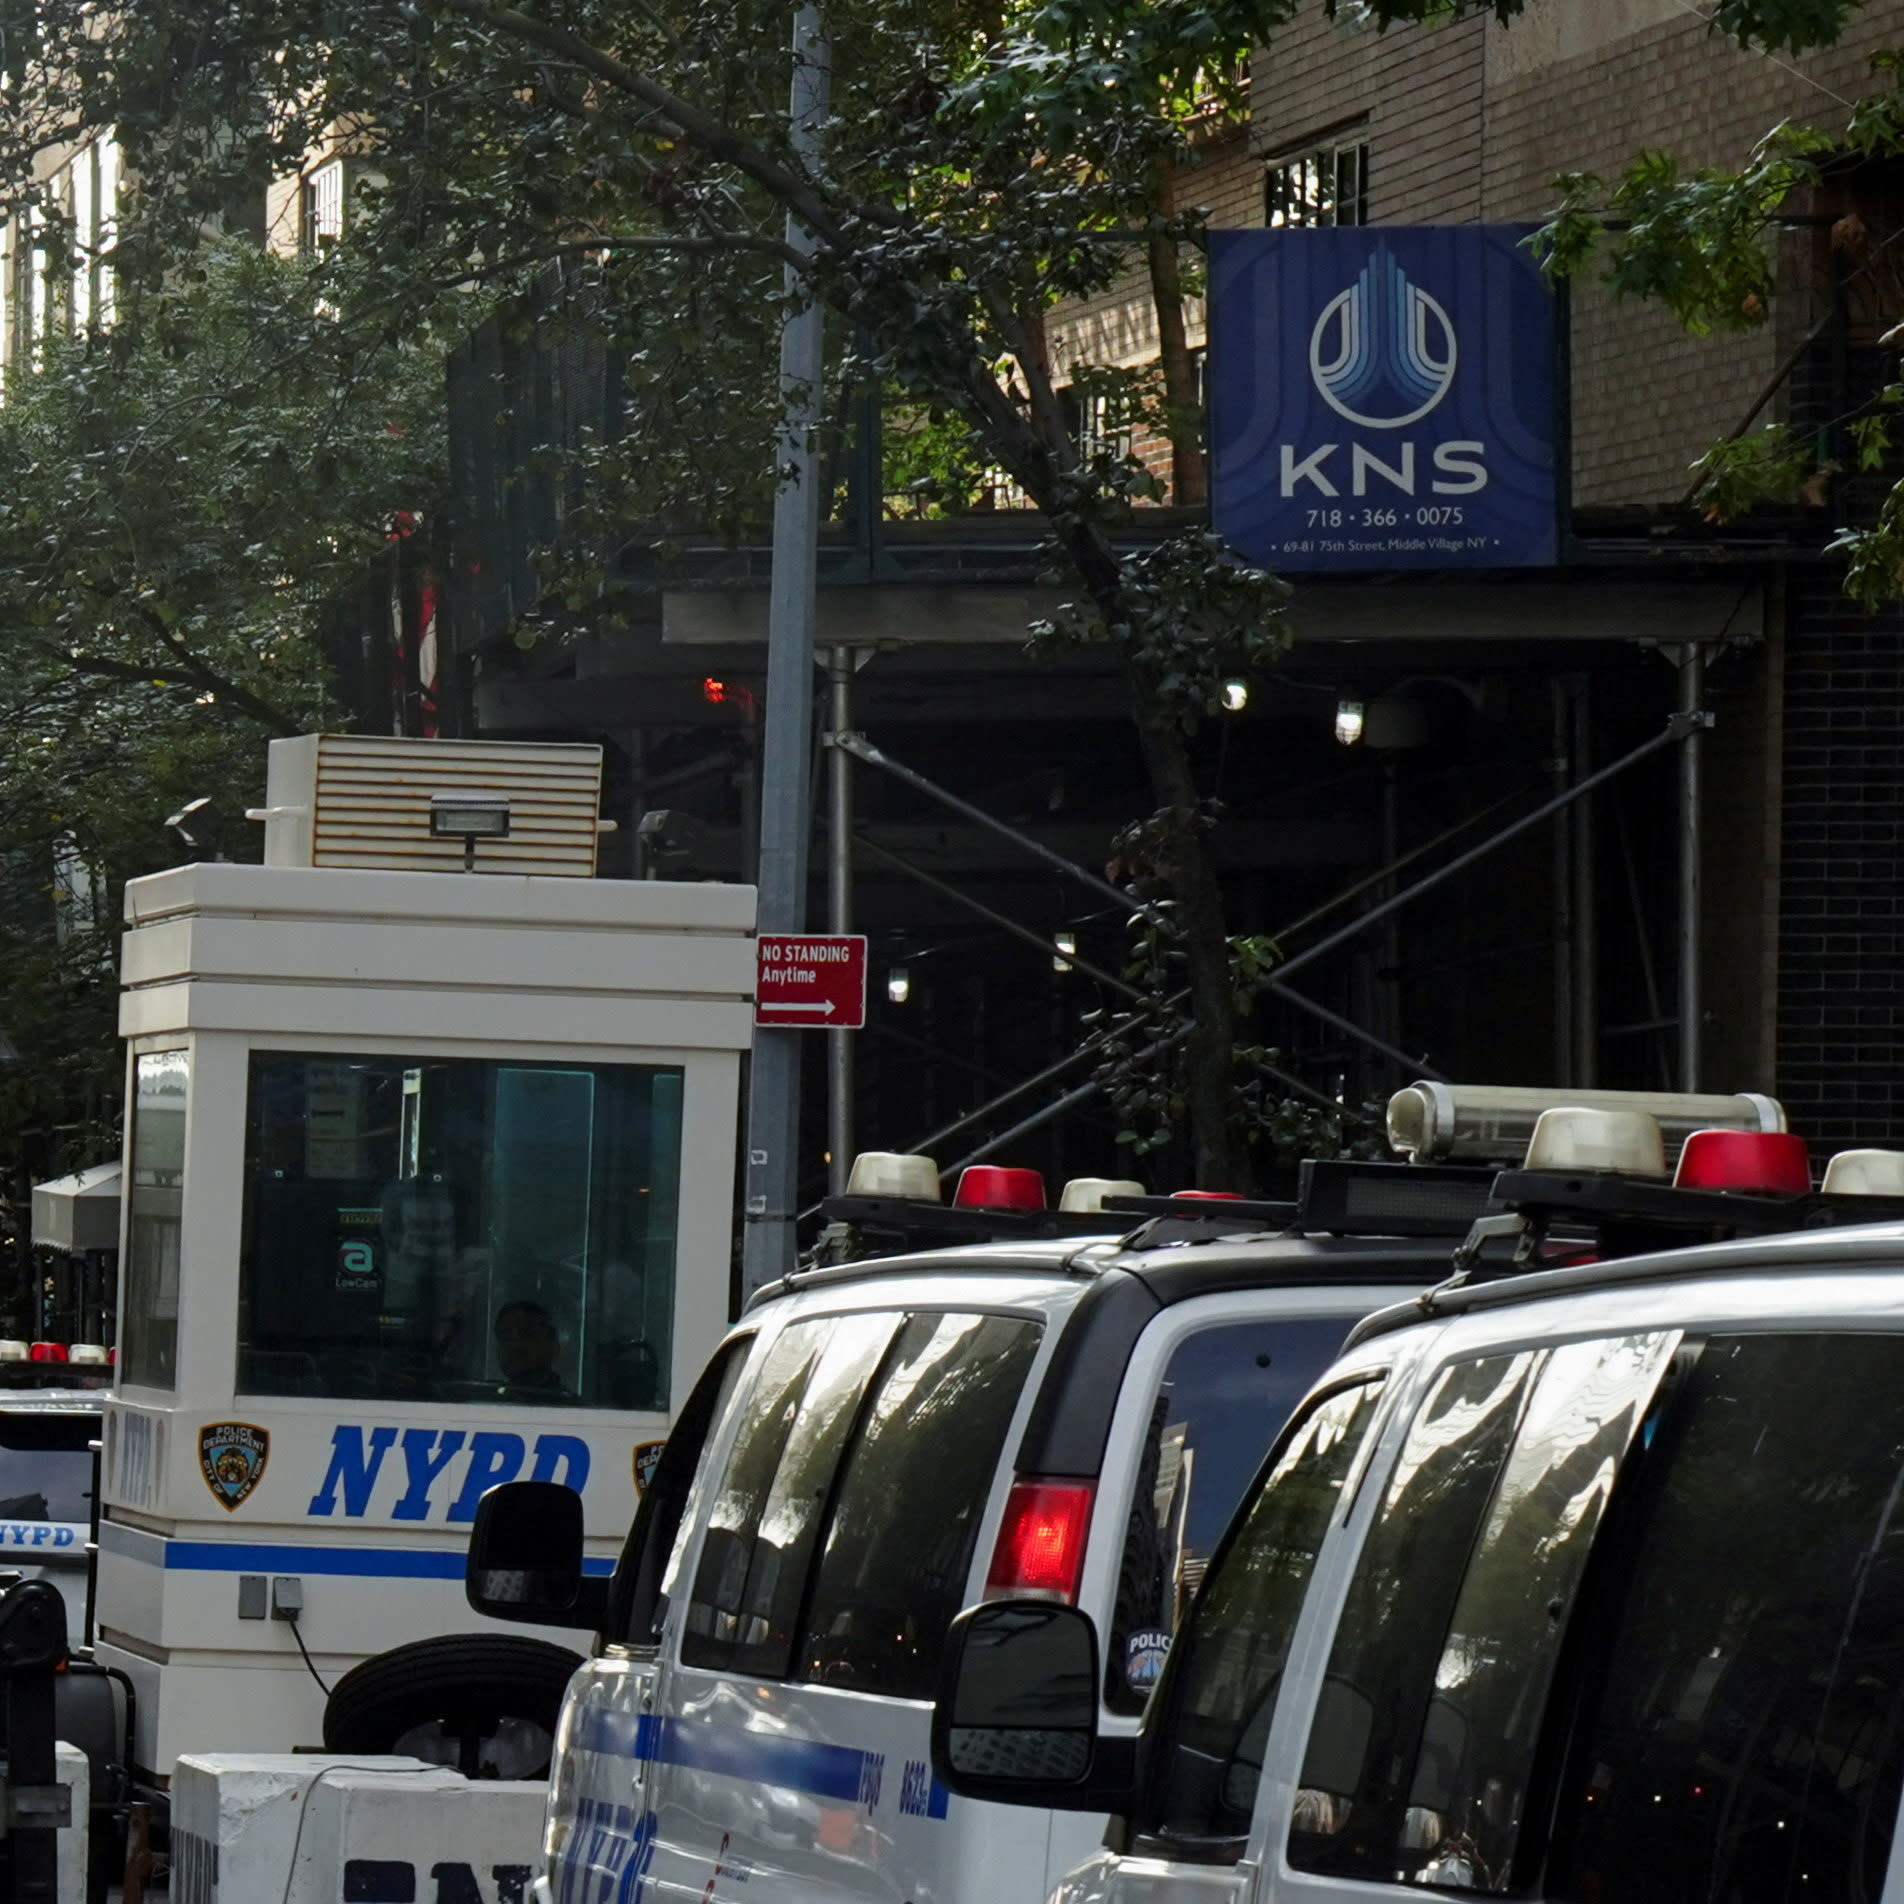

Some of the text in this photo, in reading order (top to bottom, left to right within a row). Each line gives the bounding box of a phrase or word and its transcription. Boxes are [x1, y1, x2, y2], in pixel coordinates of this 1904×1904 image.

[1279, 439, 1489, 498] KNS
[1306, 506, 1464, 528] 718 366 0075
[1318, 539, 1345, 552] 75th
[1387, 538, 1426, 550] Middle
[1426, 537, 1464, 552] Village
[1465, 537, 1487, 548] NY
[761, 944, 851, 964] NO STANDING
[761, 966, 818, 986] Anytime
[216, 1425, 254, 1438] POLICE
[202, 1434, 265, 1450] DEPARTMENT
[307, 1423, 592, 1523] NYPD
[1129, 1632, 1172, 1654] POLIC
